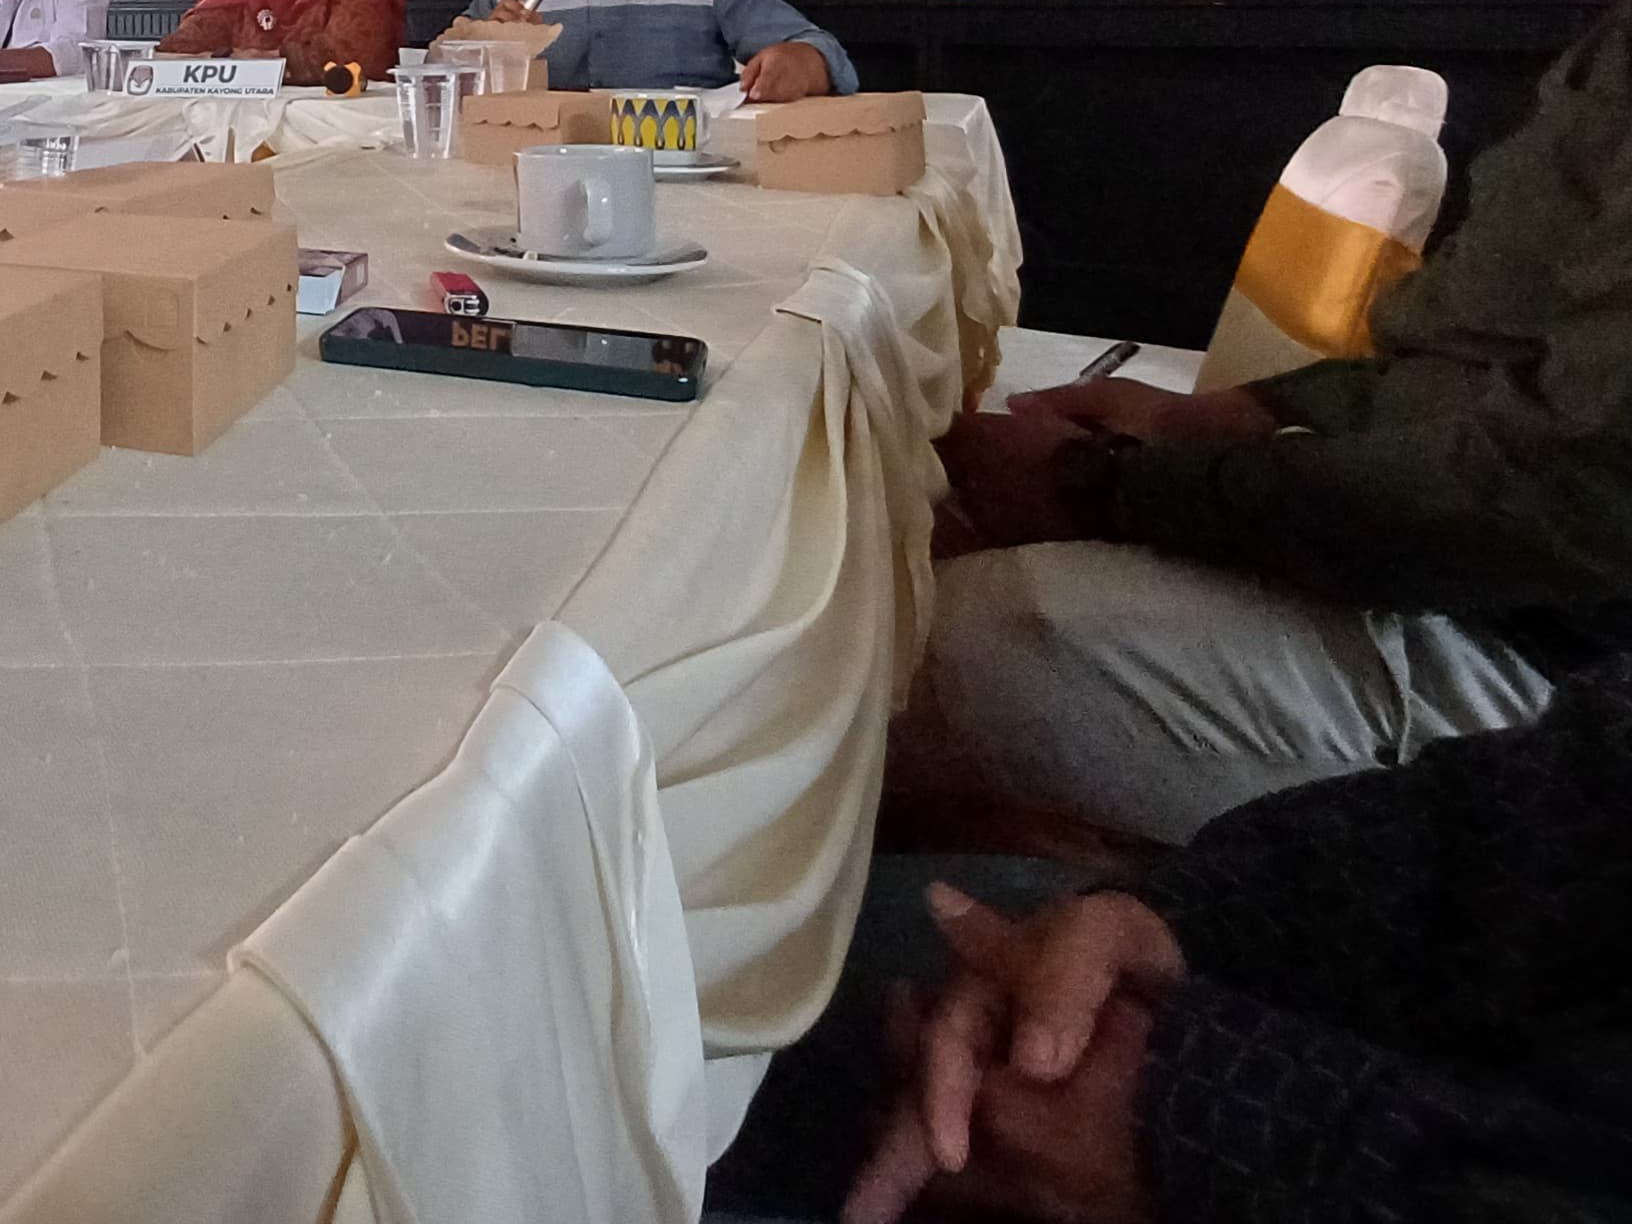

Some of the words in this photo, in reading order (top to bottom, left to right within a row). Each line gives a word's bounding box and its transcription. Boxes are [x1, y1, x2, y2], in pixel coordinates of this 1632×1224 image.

[183, 64, 237, 84] KPU
[155, 87, 206, 95] KABUPATEN
[207, 87, 243, 95] KAYONG
[244, 87, 274, 95] UTARA
